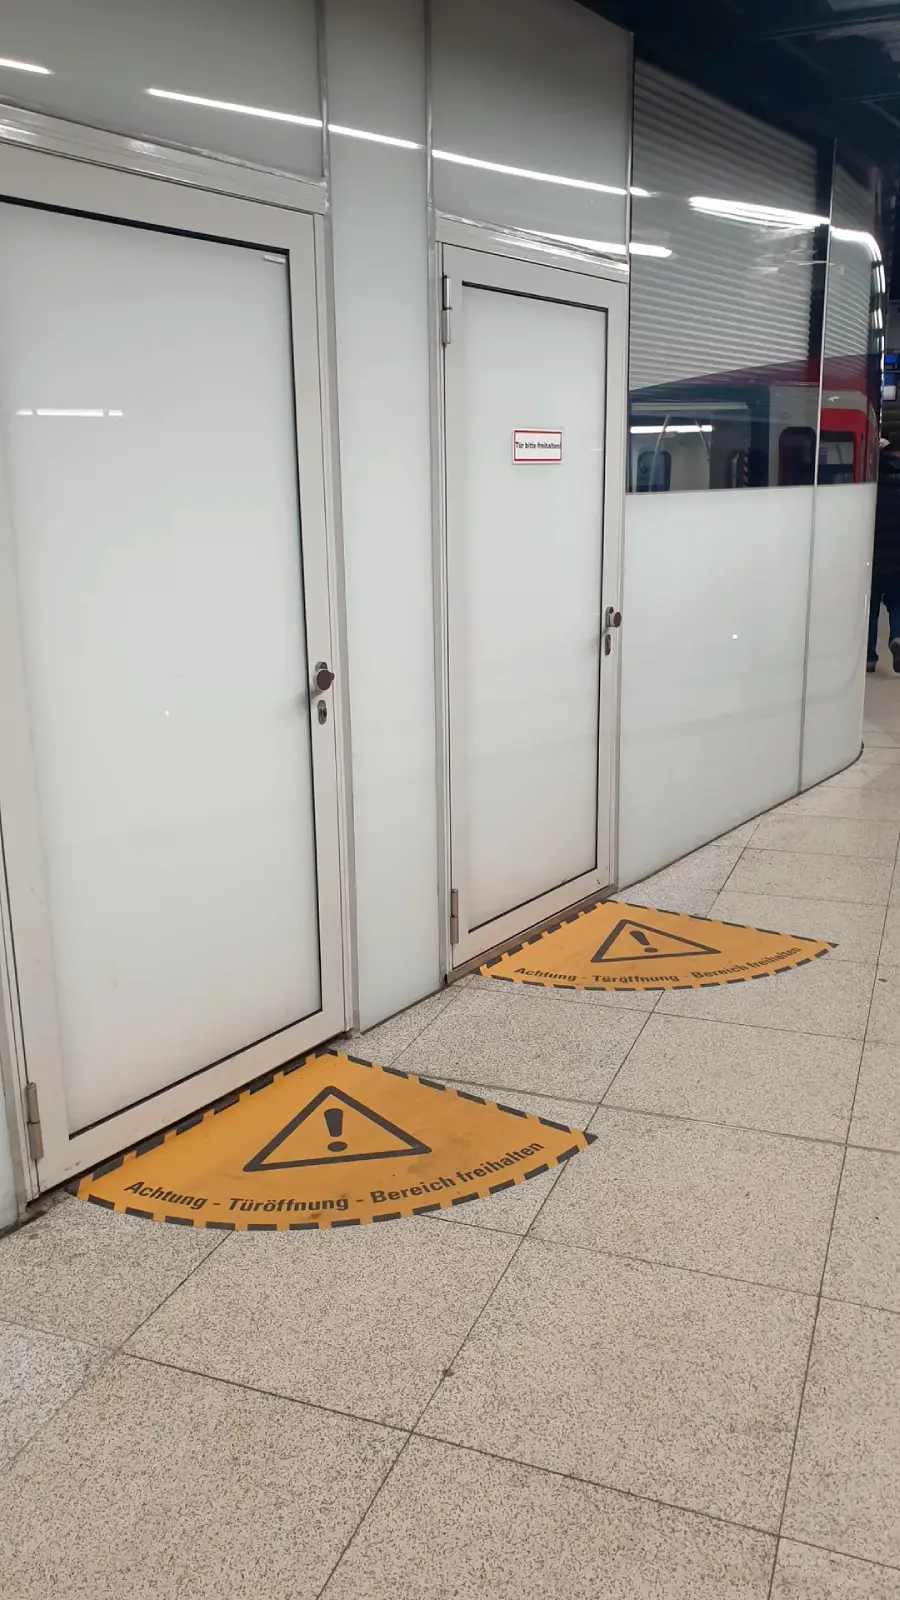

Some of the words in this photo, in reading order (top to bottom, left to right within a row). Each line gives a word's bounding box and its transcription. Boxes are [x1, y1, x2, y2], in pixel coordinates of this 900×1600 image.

[514, 967, 577, 982] Achtung
[592, 974, 680, 983] Türöffnung
[691, 964, 750, 979] Bereich
[749, 947, 803, 969] freihalten
[124, 1181, 208, 1210] Achtung
[229, 1197, 349, 1213] Türöffnung
[370, 1176, 456, 1204] Bereich
[456, 1142, 545, 1183] freihalten
